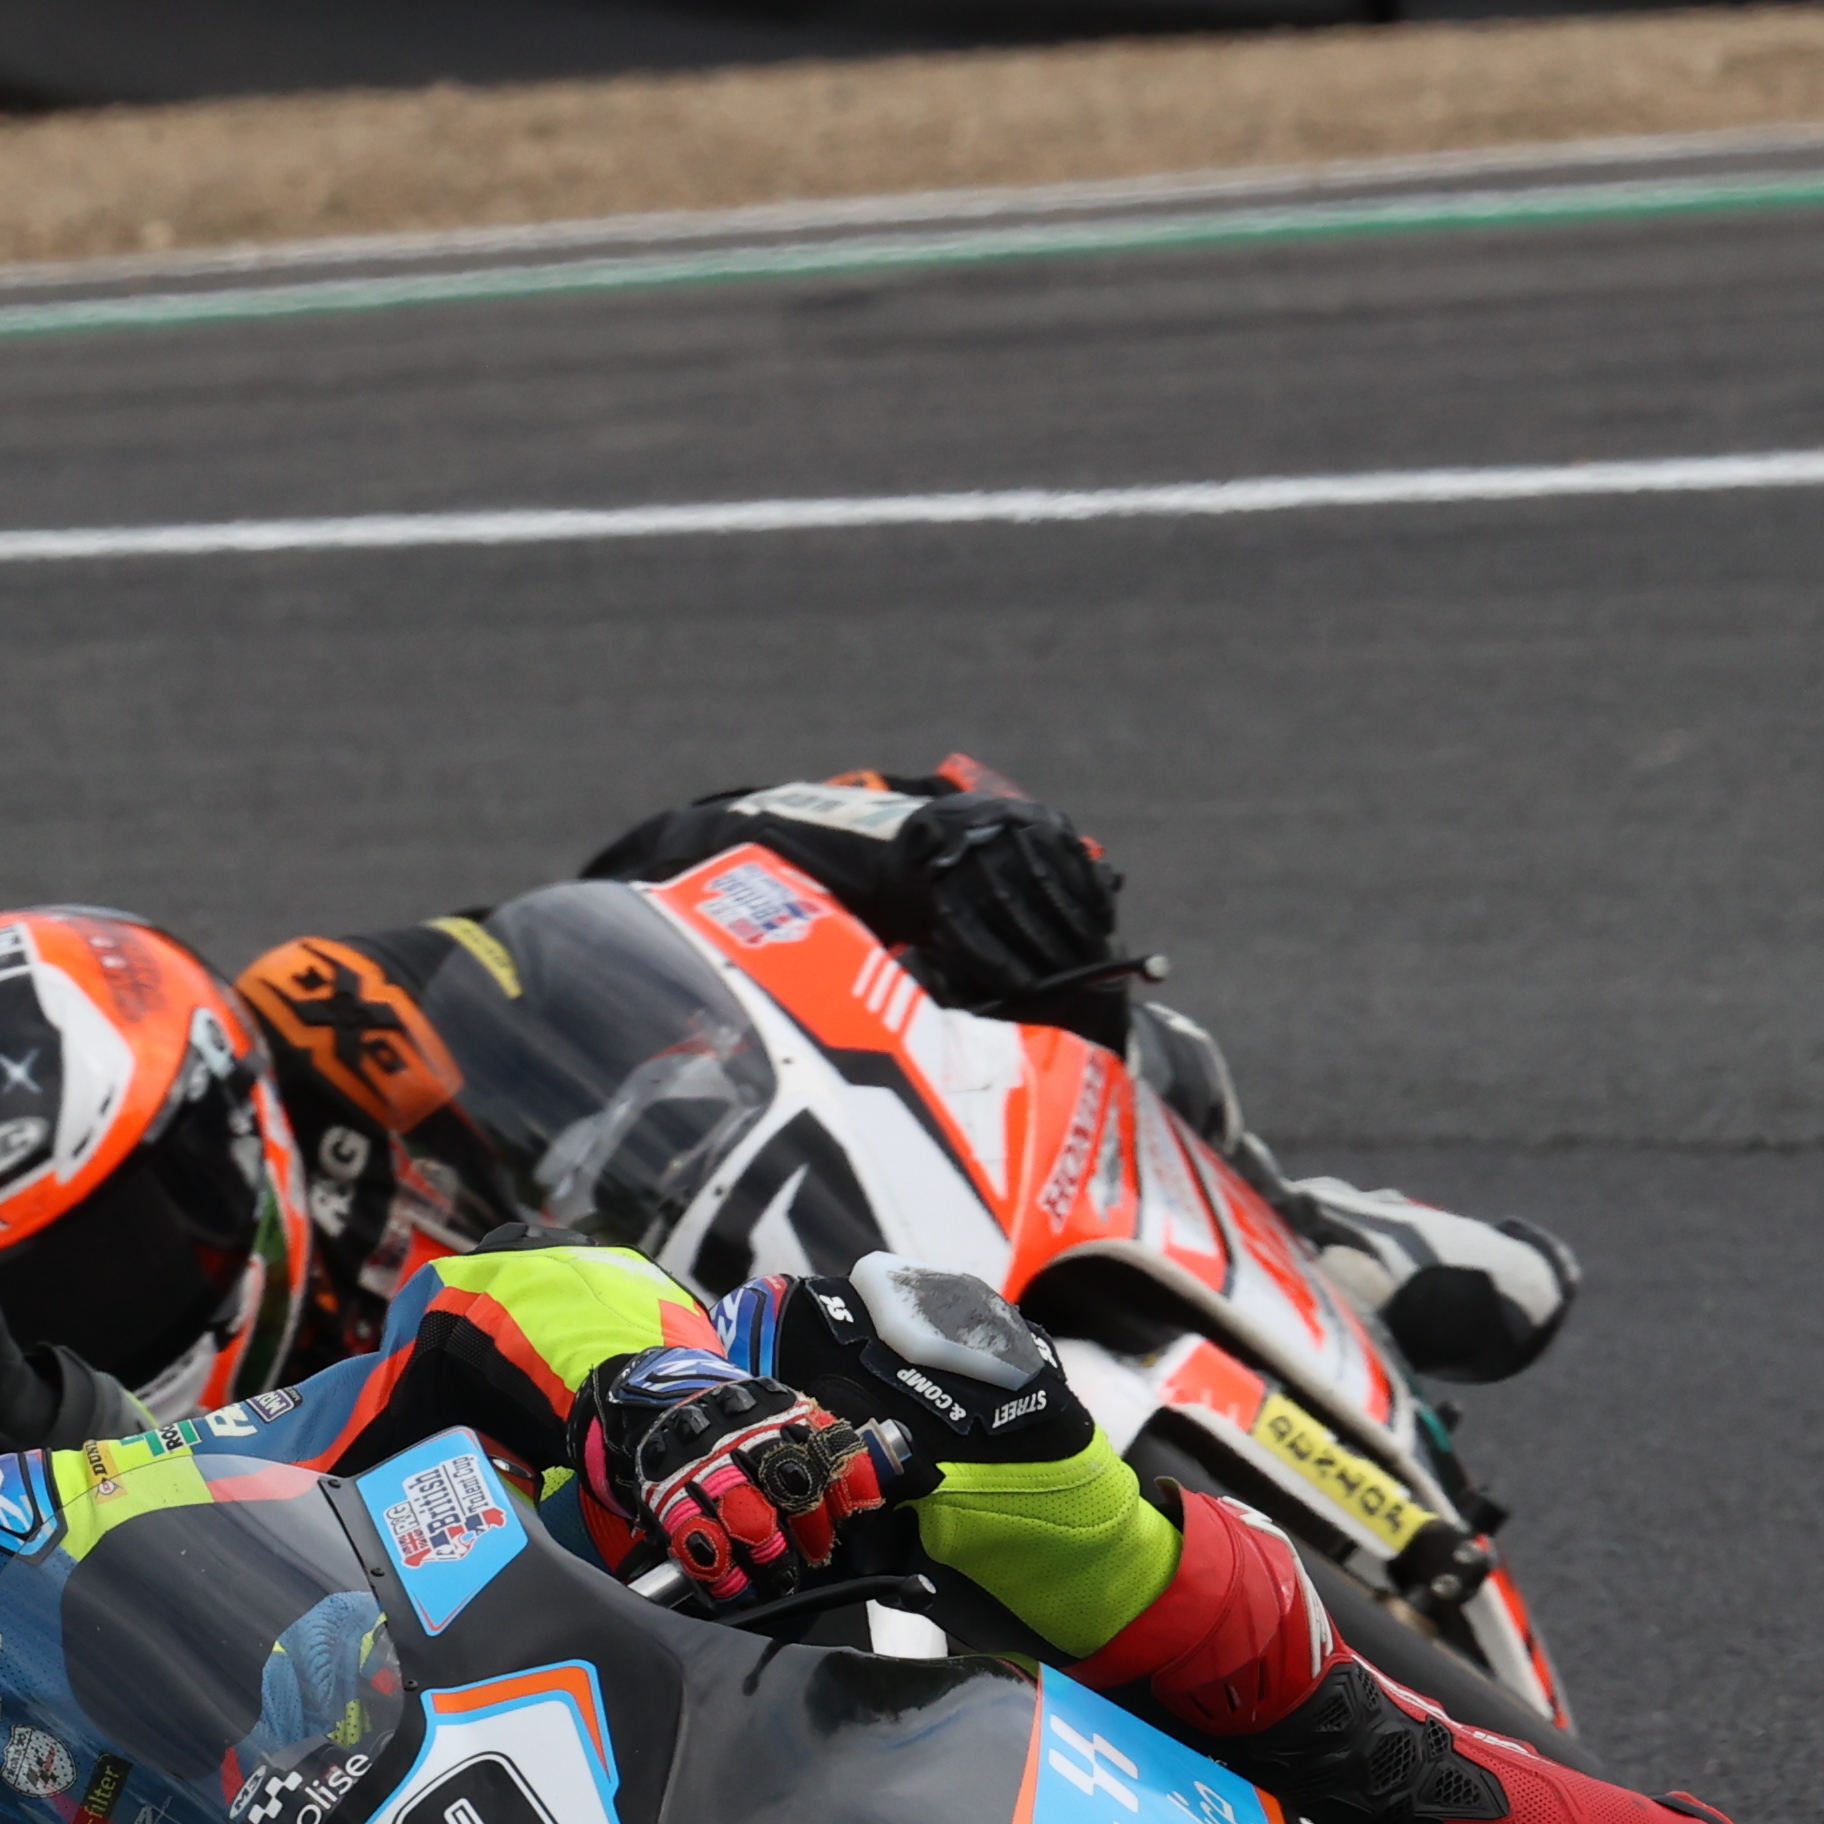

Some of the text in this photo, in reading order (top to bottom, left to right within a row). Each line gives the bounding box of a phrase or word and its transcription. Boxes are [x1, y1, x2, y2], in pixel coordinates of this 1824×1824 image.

[896, 1368, 1048, 1429] STREET & COMP
[407, 1467, 462, 1534] British
